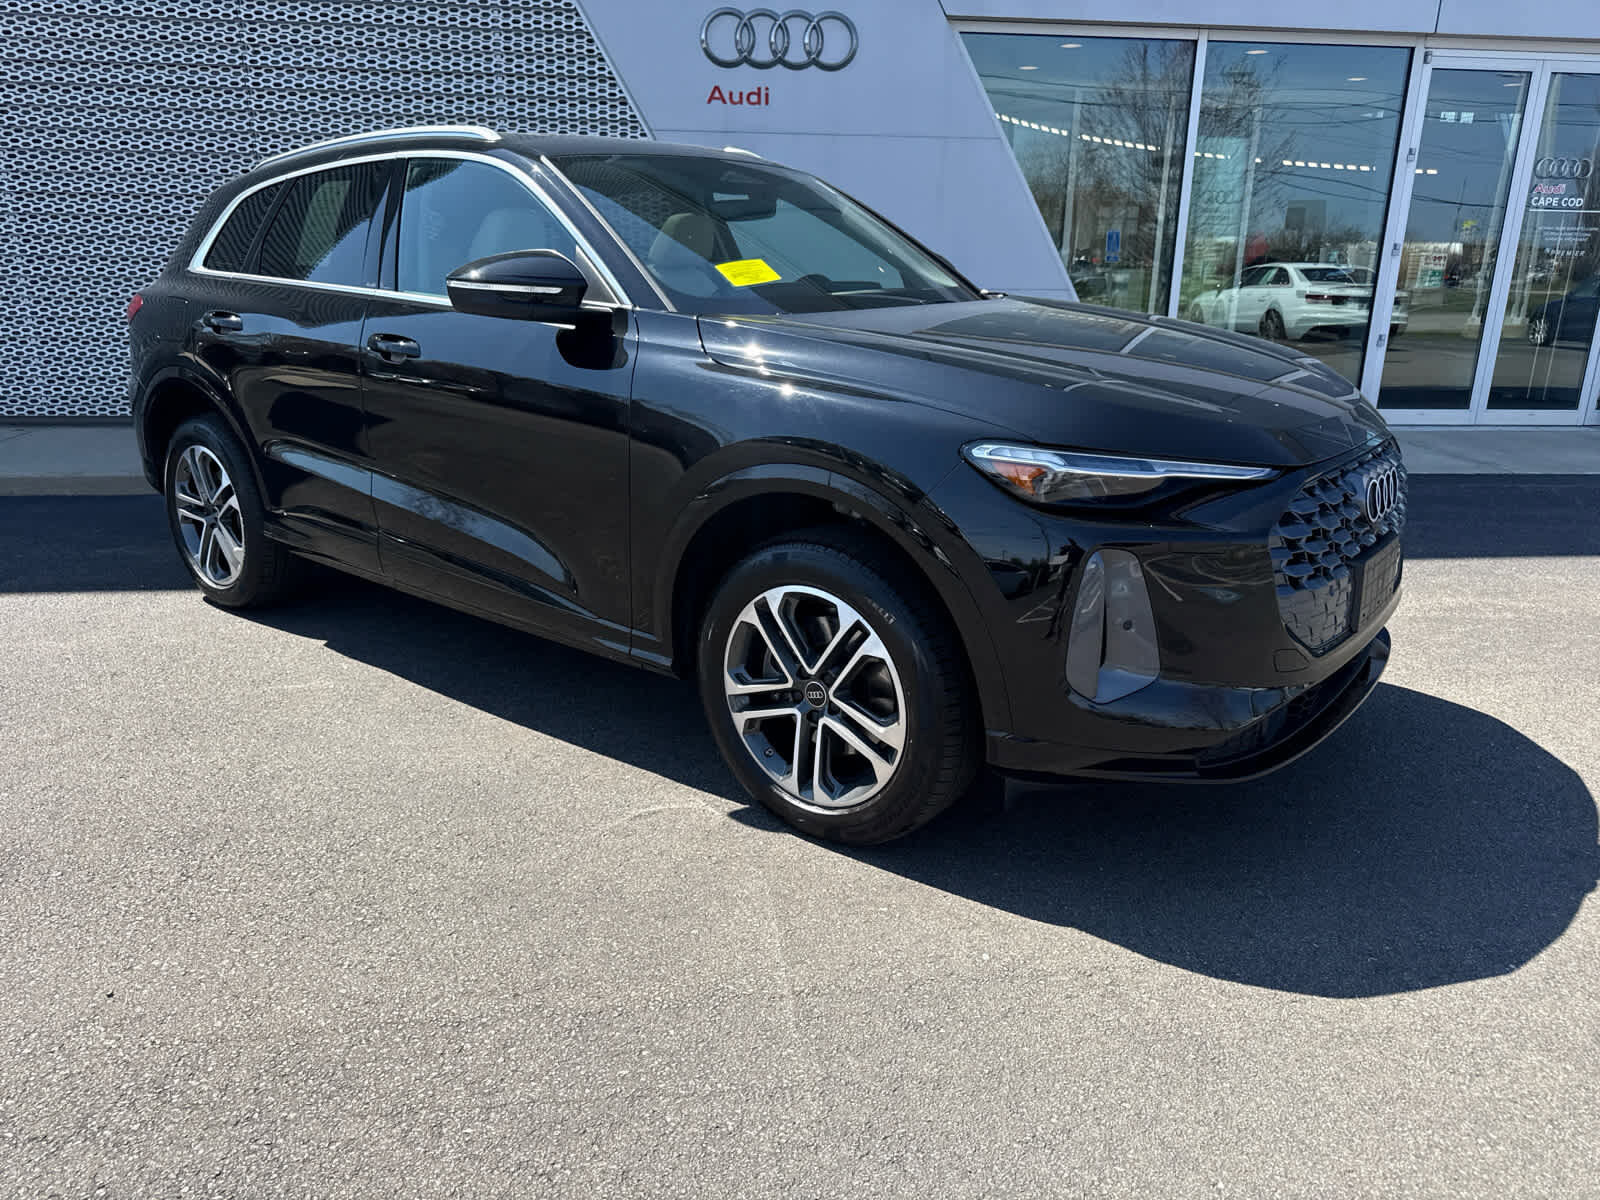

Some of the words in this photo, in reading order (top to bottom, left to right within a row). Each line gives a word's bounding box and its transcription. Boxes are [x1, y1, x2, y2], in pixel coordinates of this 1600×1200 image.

[706, 84, 770, 106] Audi
[1533, 183, 1567, 195] Audi
[1531, 196, 1560, 207] CAPE
[1561, 197, 1584, 207] COD
